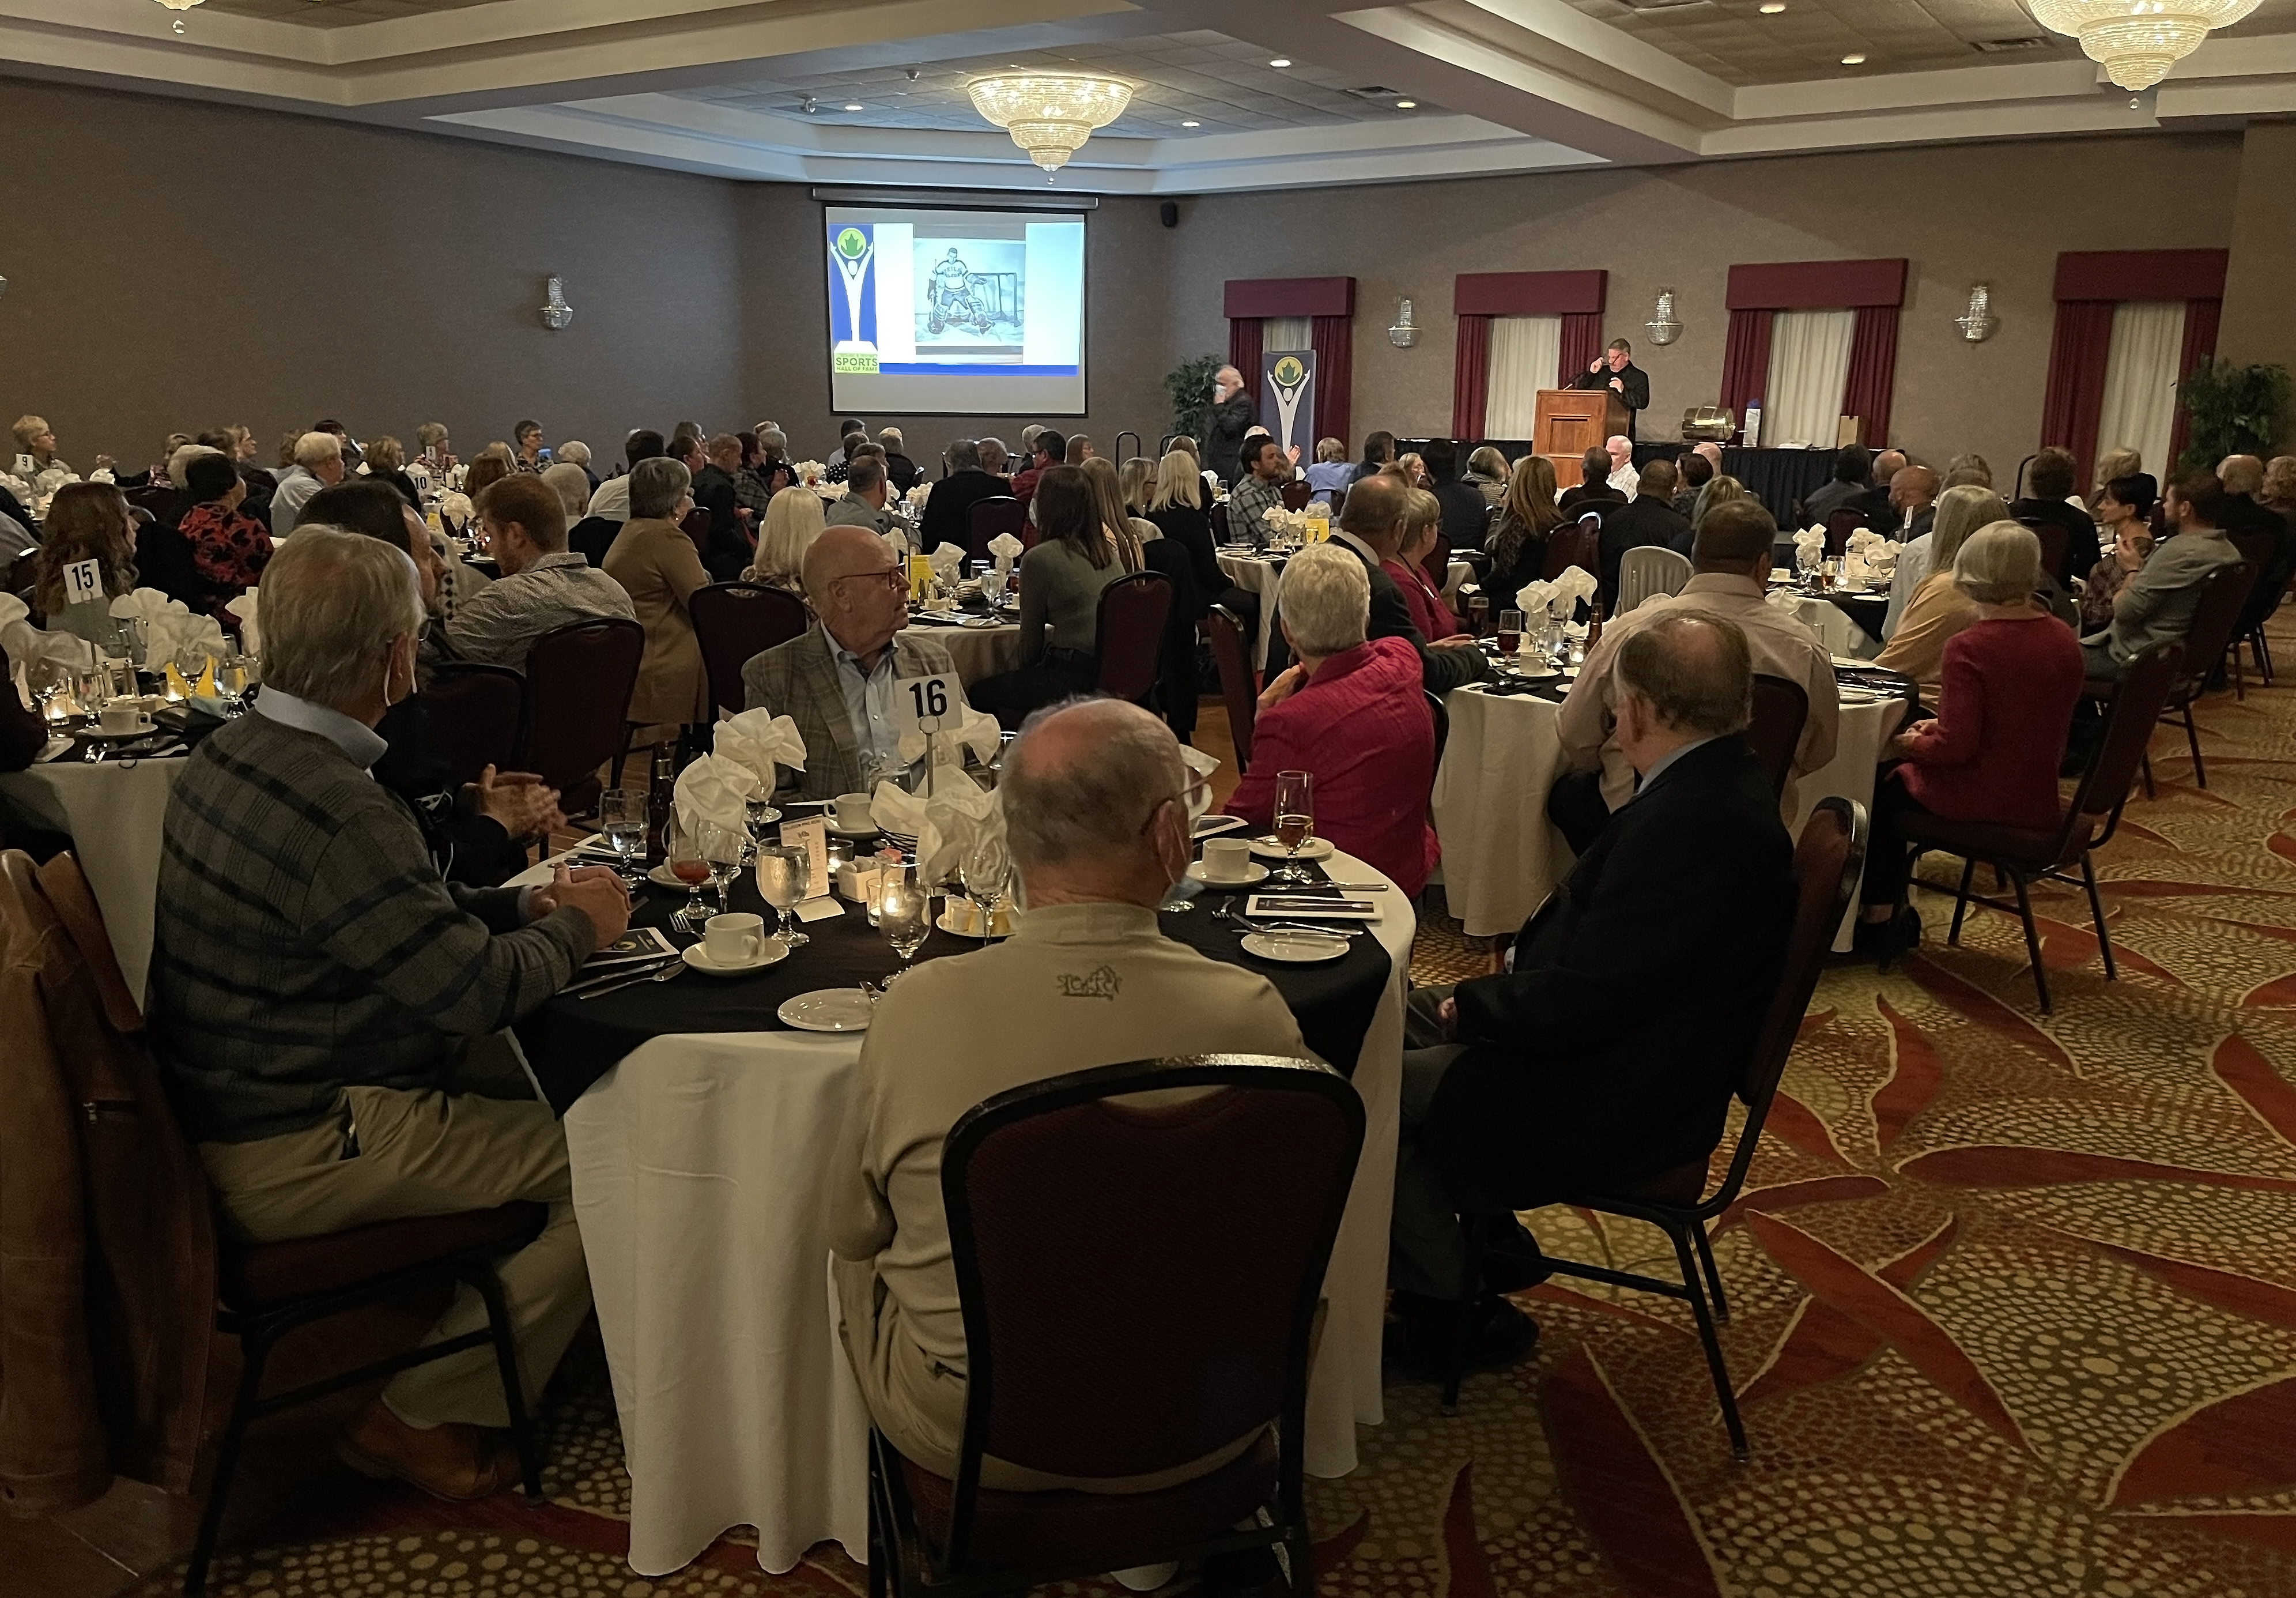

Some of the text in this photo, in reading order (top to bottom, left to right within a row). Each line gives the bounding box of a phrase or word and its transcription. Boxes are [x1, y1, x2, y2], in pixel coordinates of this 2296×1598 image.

[836, 357, 878, 367] SPORTS
[22, 456, 28, 466] 9
[414, 476, 427, 490] 10
[71, 563, 94, 591] 15
[909, 679, 947, 718] 16
